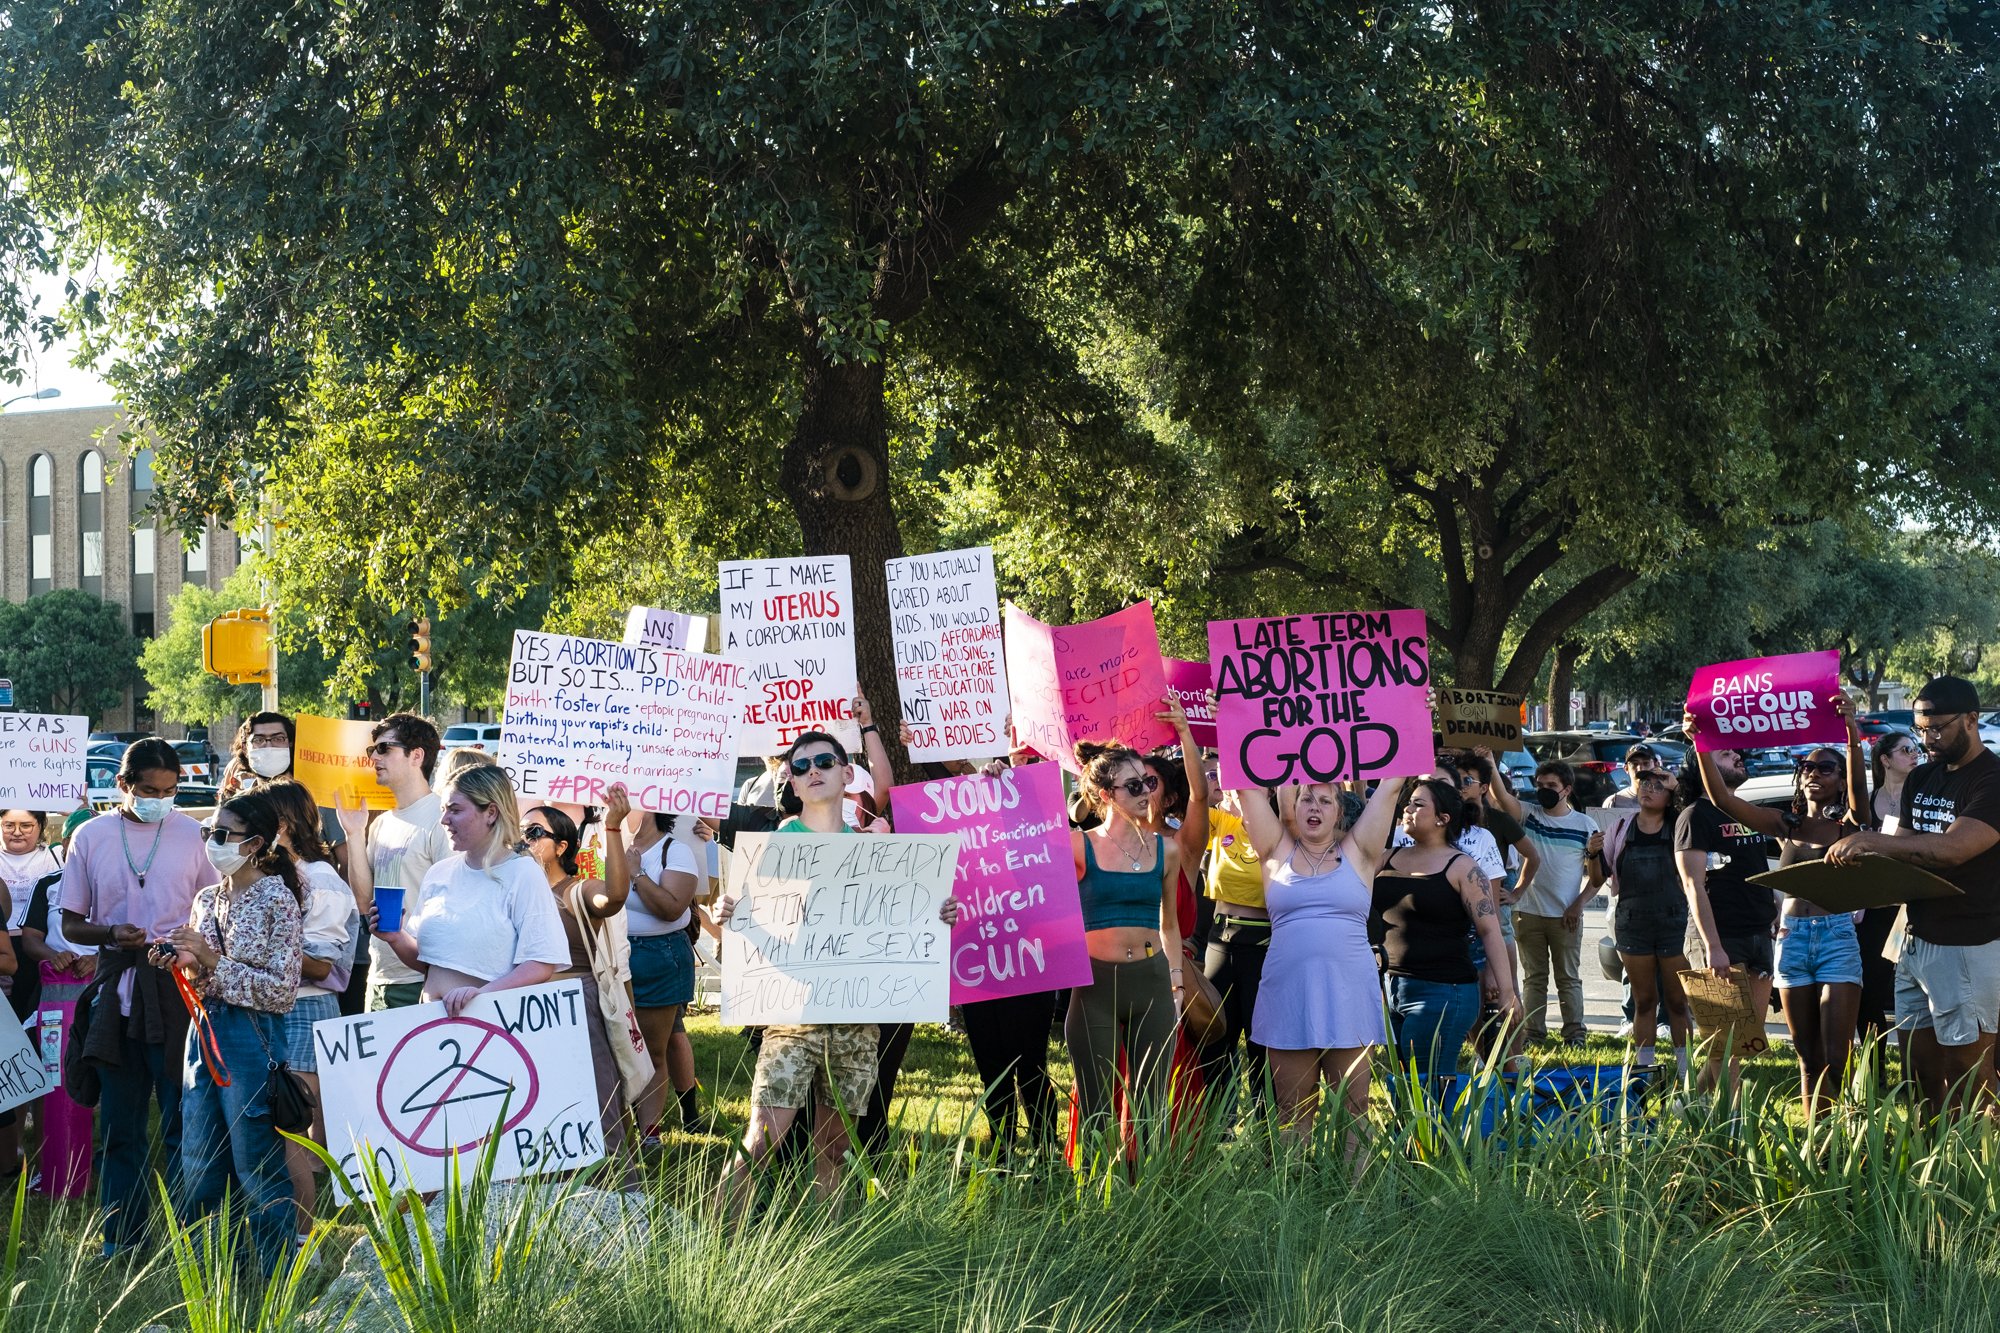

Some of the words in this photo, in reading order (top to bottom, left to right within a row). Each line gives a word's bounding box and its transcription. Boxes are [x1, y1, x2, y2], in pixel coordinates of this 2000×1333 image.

[723, 567, 754, 591] IF
[764, 567, 782, 588] I
[790, 563, 836, 585] MAKE
[886, 561, 902, 582] IF
[909, 560, 929, 583] YOU
[933, 553, 981, 580] ACTUALLY
[730, 600, 753, 620] MY
[763, 590, 840, 622] UTERUS
[890, 586, 930, 610] CARED
[936, 582, 972, 605] ABOUT
[928, 612, 948, 630] YOU
[951, 606, 990, 627] WOULD
[1233, 617, 1305, 650] LATE
[1311, 612, 1392, 642] TERM
[727, 631, 738, 650] A
[746, 621, 846, 647] CORPORATION
[940, 623, 1001, 647] AFFORDABLE
[556, 638, 637, 671] ABORTION
[636, 647, 658, 675] IS
[794, 658, 825, 676] YOU
[942, 644, 996, 662] HOUSING,
[1065, 666, 1091, 681] are
[1099, 646, 1139, 673] more
[512, 661, 553, 685] BUT
[558, 667, 585, 687] SO
[589, 669, 634, 692] IS...
[641, 676, 679, 696] PPD
[898, 665, 924, 681] FREE
[927, 662, 968, 681] HEALTH
[970, 660, 997, 677] CARE
[1214, 635, 1429, 701] ABORTIONS
[762, 679, 814, 704] STOP
[1712, 672, 1773, 696] BANS
[509, 687, 547, 708] birth
[554, 688, 601, 713] foster
[640, 702, 675, 720] eptopic
[677, 707, 728, 734] pregnancy
[742, 698, 853, 724] REGULATING
[903, 698, 932, 722] NOT
[939, 700, 971, 722] WAR
[975, 699, 993, 717] ON
[1262, 695, 1314, 728] FOR
[1315, 689, 1370, 724] THE
[1440, 690, 1520, 707] ABORTION
[1460, 703, 1487, 720] ON
[1710, 694, 1756, 716] OFF
[1758, 690, 1817, 713] OUR
[0, 716, 71, 734] EXAS:
[1051, 707, 1089, 724] than
[1081, 721, 1101, 735] our
[1714, 711, 1811, 734] BODIES
[505, 709, 558, 739] birthing
[560, 718, 587, 738] your
[588, 717, 629, 737] rapist's
[632, 721, 662, 737] child
[673, 726, 726, 755] poverty
[912, 727, 940, 749] OUR
[944, 722, 996, 748] BODIES
[1446, 720, 1518, 740] DEMAND
[28, 736, 77, 754] GUNS
[299, 748, 349, 767] LIBERATE
[504, 730, 569, 749] maternal
[573, 738, 632, 761] mortality
[641, 742, 674, 758] unsafe
[677, 745, 730, 761] abortions
[43, 756, 82, 777] Rights
[503, 766, 537, 794] BE
[516, 750, 566, 768] shame
[584, 753, 629, 776] forced
[633, 761, 693, 783] marriages
[920, 768, 1020, 824] SCOTUS
[954, 823, 991, 853] NLY
[991, 812, 1062, 844] sanctioned
[833, 841, 950, 882] ALREADY
[975, 856, 1001, 877] to
[1005, 843, 1052, 871] End
[728, 886, 827, 932] GETTING
[978, 922, 998, 940] is
[1003, 916, 1019, 933] a
[743, 933, 792, 966] WHY
[803, 932, 854, 962] HAVE
[859, 931, 937, 960] SEX?
[951, 937, 1045, 988] GUN
[315, 1020, 377, 1065] WE
[494, 988, 580, 1036] WON'T
[513, 1120, 598, 1168] BACK
